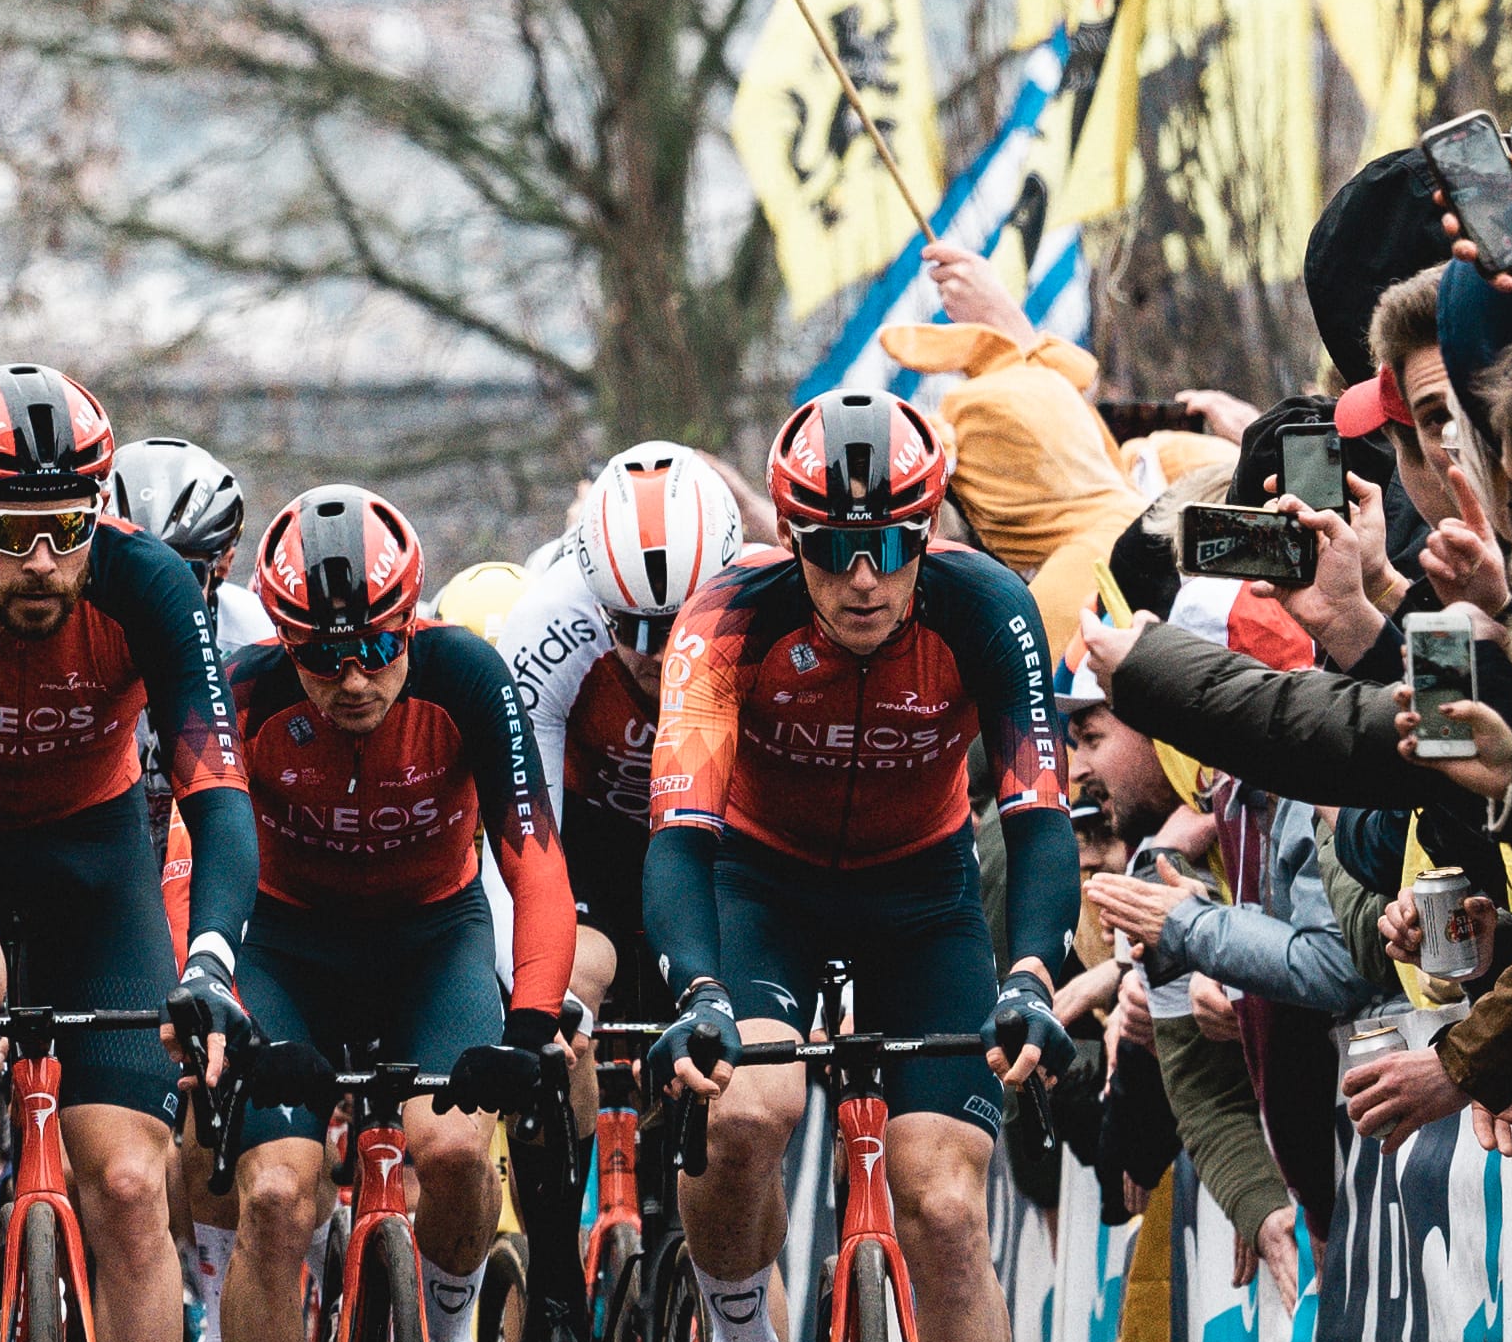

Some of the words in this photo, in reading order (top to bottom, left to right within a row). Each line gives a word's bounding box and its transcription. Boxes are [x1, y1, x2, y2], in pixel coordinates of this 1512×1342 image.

[846, 511, 873, 521] KASK
[329, 624, 355, 634] KASK
[514, 616, 598, 711] ofidis
[192, 610, 236, 767] GRENADIER
[656, 626, 706, 749] INEOS
[1008, 614, 1056, 771] GRENADIER
[875, 701, 950, 715] PINARELLO
[773, 721, 940, 752] INEOS
[500, 685, 536, 837] GRENADIER
[287, 797, 440, 833] INEOS
[260, 810, 464, 854] GRENADIER
[54, 1013, 97, 1025] MOST
[601, 1022, 659, 1031] LOOK
[796, 1044, 836, 1057] MOST
[883, 1040, 925, 1052] MOST
